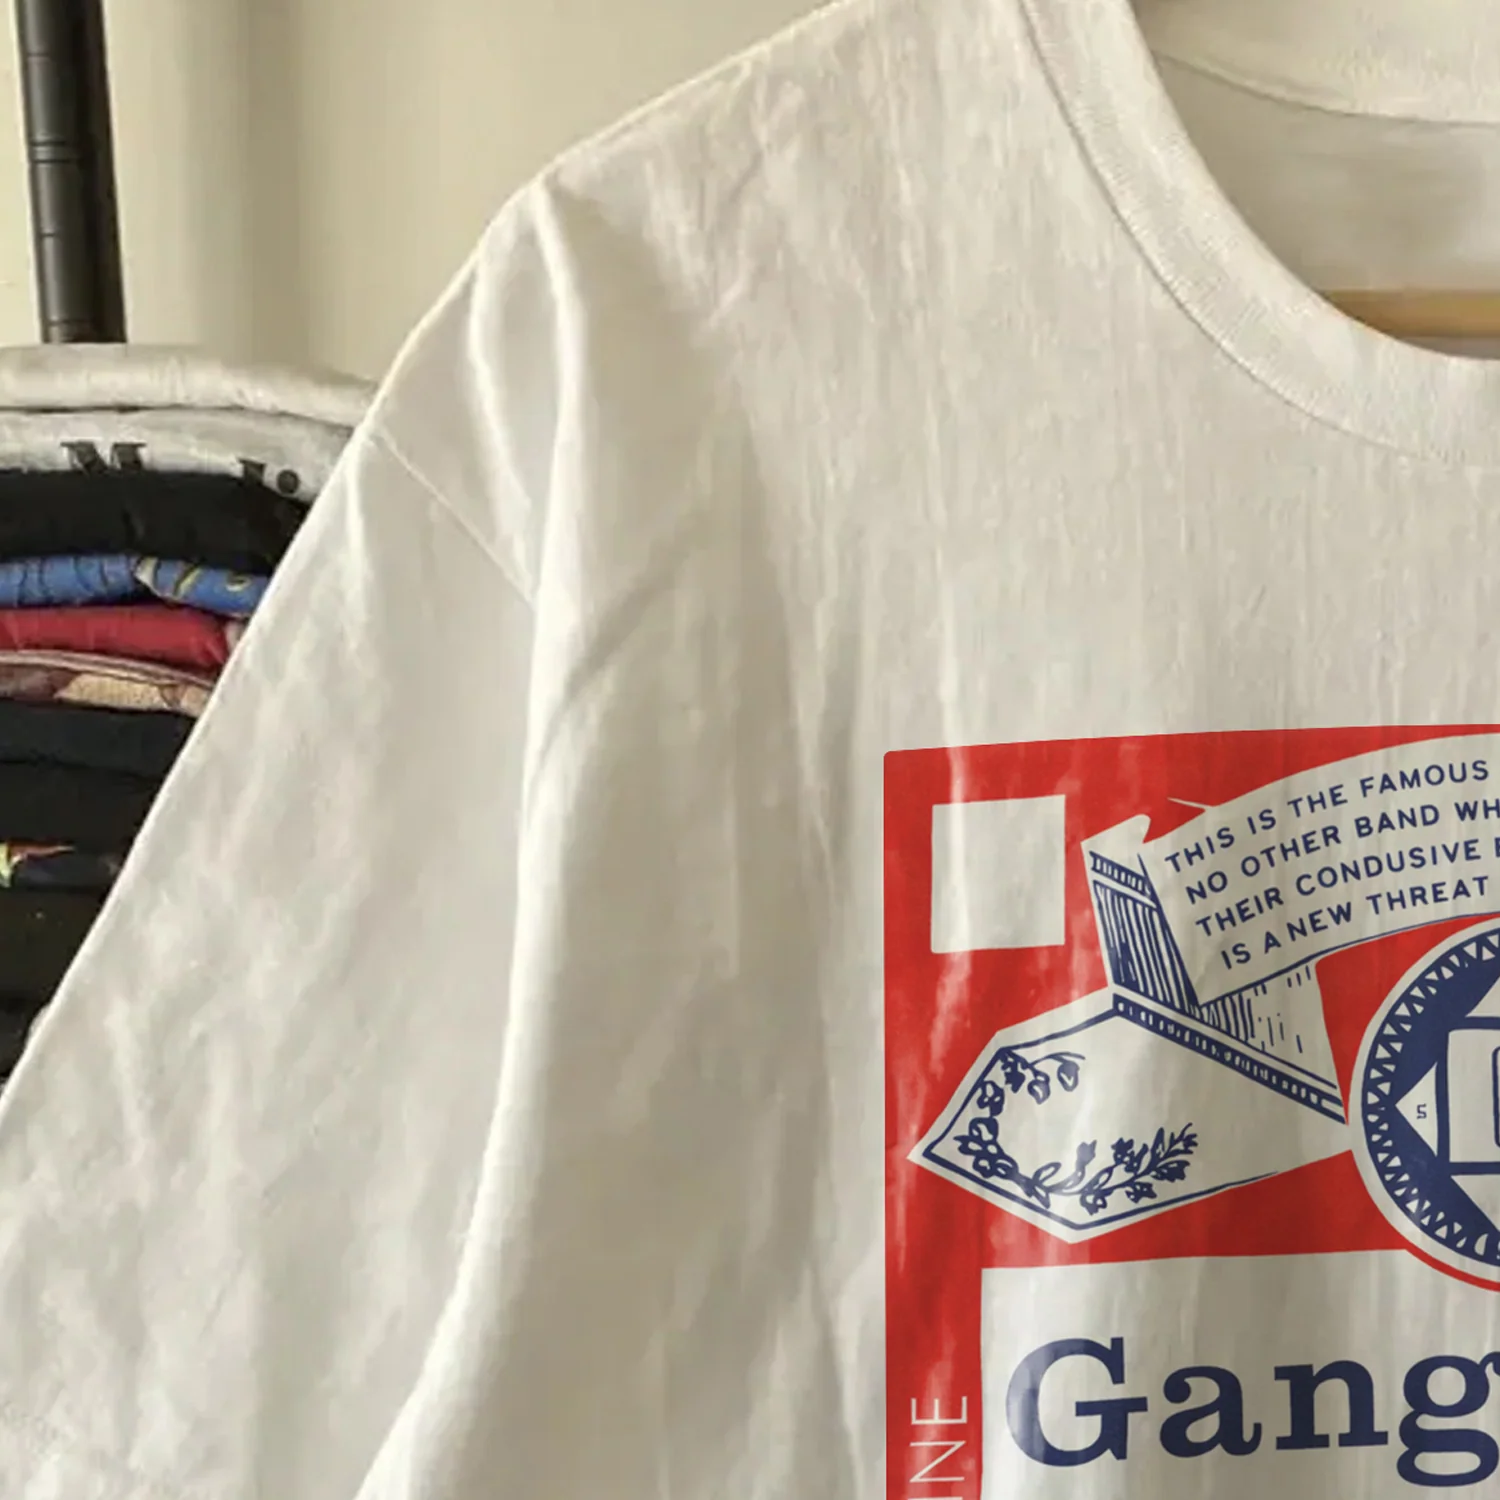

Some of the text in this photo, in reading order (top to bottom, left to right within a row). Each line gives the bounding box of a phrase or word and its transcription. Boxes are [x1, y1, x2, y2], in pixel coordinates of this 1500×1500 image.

[1164, 826, 1235, 873] THIS
[1247, 808, 1276, 835] IS
[1288, 784, 1348, 818] THE
[1359, 759, 1489, 798] FAMOUS
[1185, 870, 1228, 904] NO
[1240, 825, 1342, 878] OTHER
[1354, 804, 1440, 839] BAND
[1195, 887, 1283, 936] THEIR
[1295, 838, 1482, 897] CONDUSIVE
[1221, 943, 1251, 969] IS
[1264, 931, 1281, 952] A
[1287, 901, 1352, 941] NEW
[1366, 875, 1489, 915] THREAT
